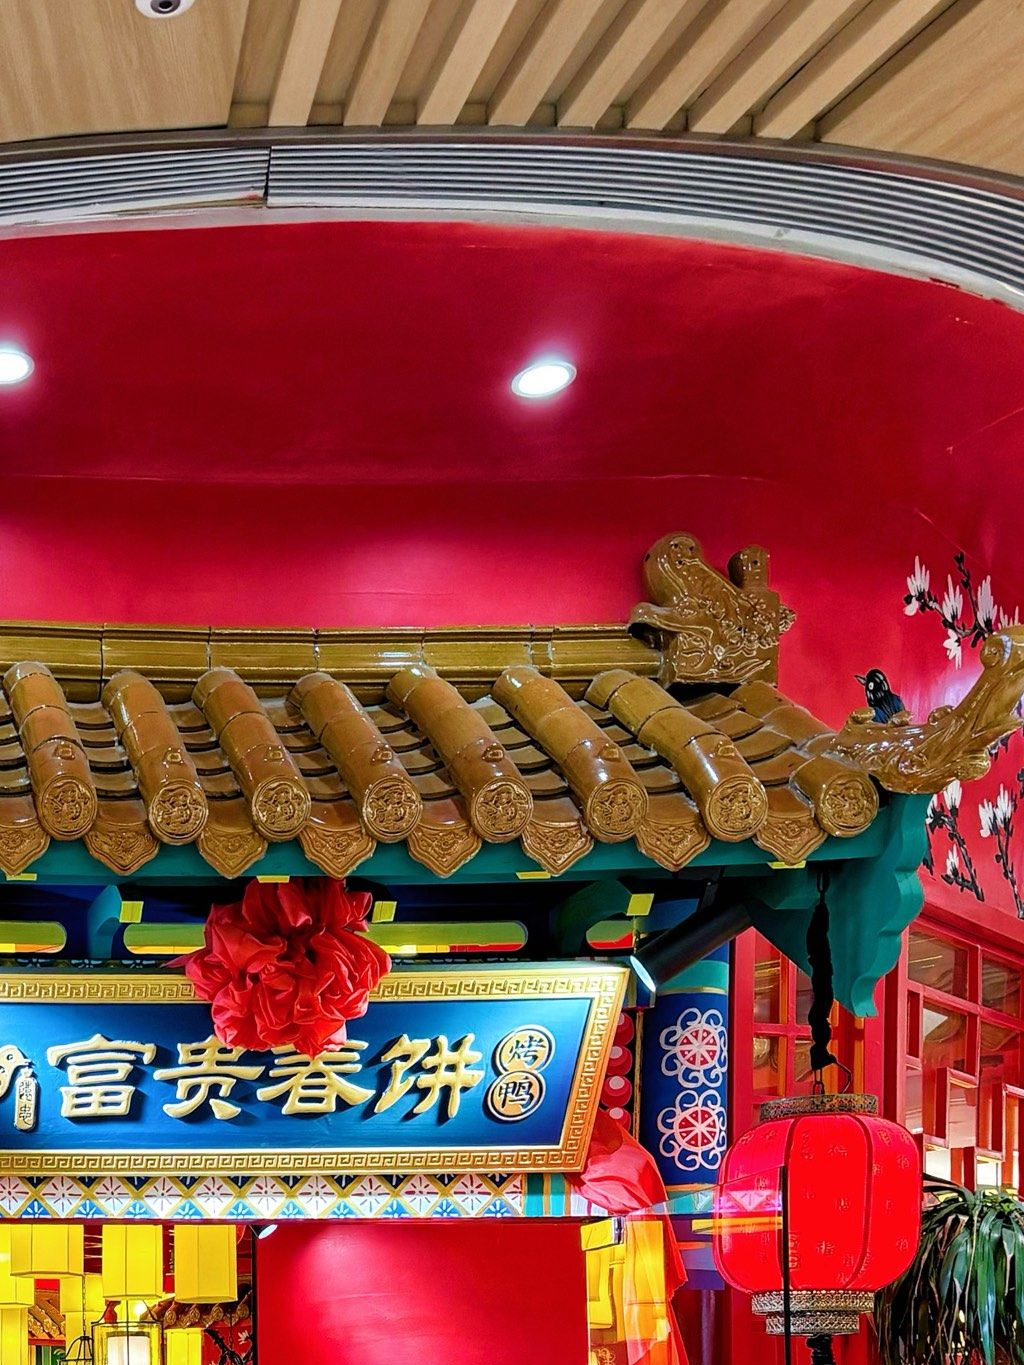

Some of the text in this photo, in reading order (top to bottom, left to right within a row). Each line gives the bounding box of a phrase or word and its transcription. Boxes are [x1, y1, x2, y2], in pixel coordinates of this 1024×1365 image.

[46, 1033, 486, 1120] 富贵春饼
[497, 1034, 548, 1111] 烤鸭
